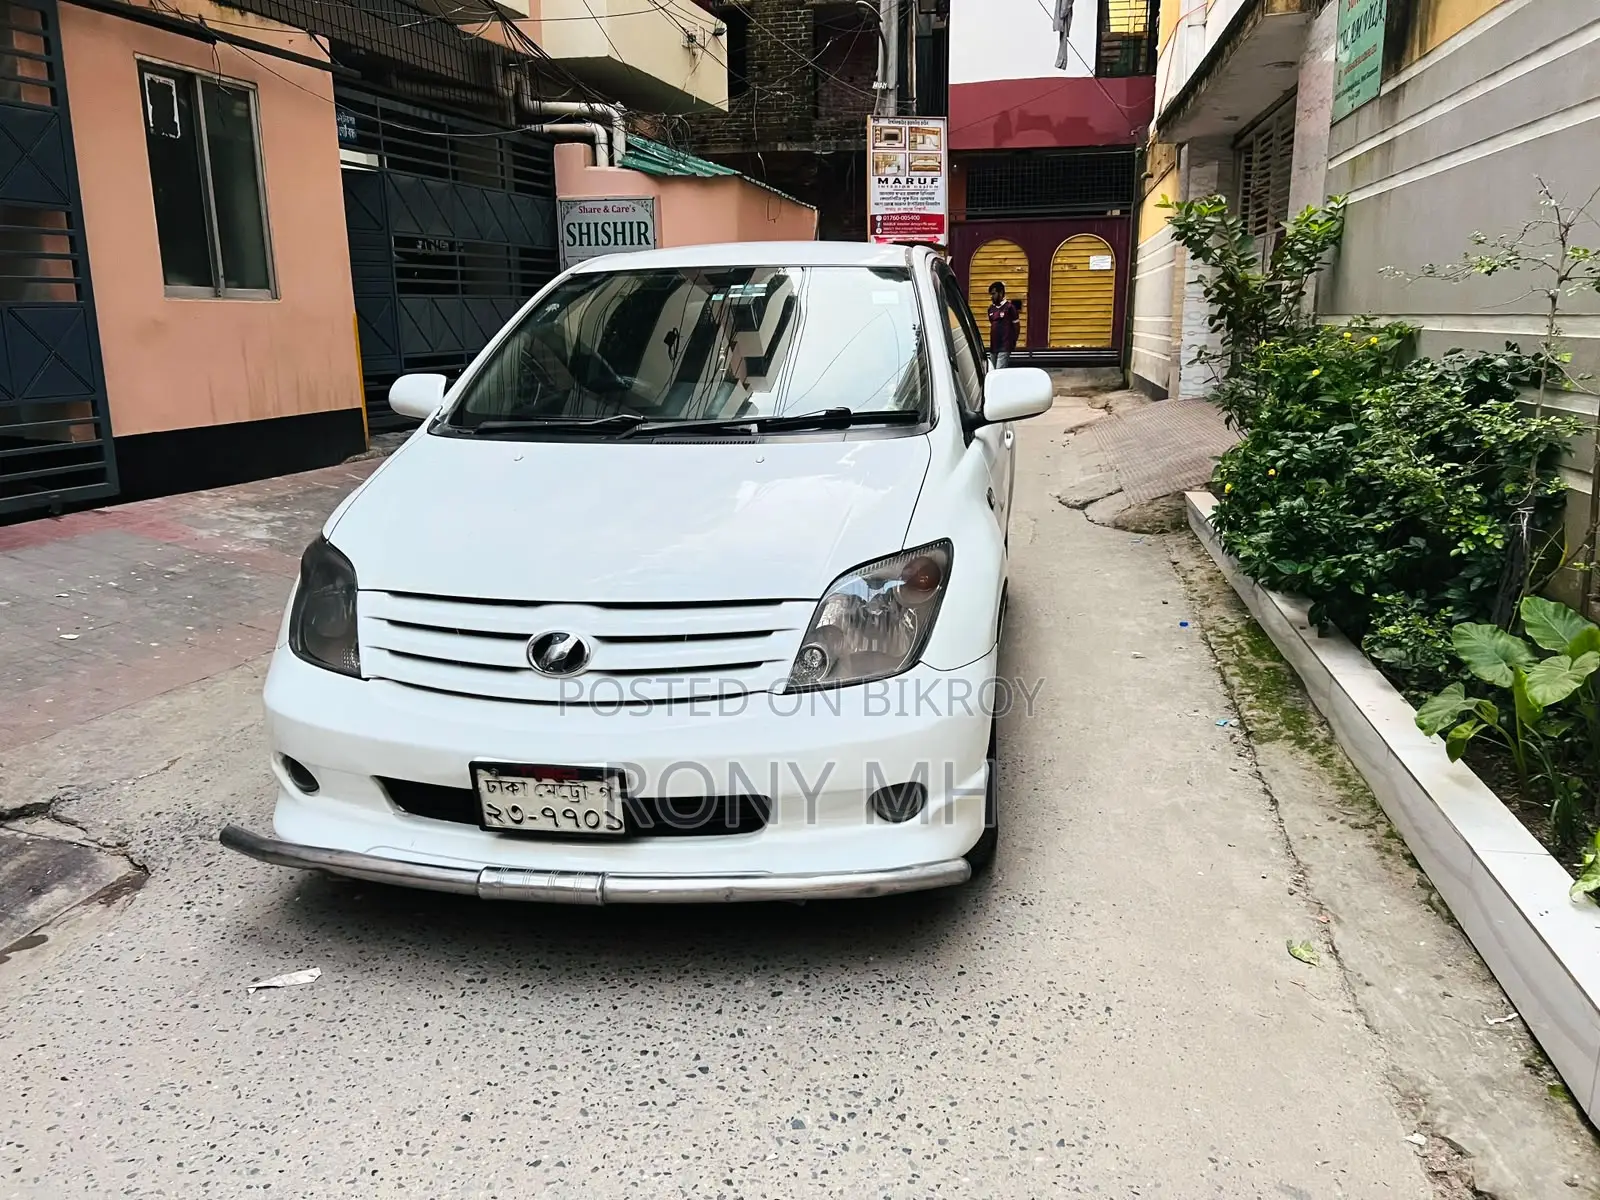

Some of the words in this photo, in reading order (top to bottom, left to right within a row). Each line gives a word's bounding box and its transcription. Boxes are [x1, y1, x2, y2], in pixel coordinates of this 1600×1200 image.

[878, 177, 938, 185] MARUF
[578, 205, 601, 214] Share
[603, 205, 610, 213] &
[611, 204, 636, 213] Care's
[566, 221, 651, 247] SHISHIR
[484, 780, 527, 796] ঢাকা
